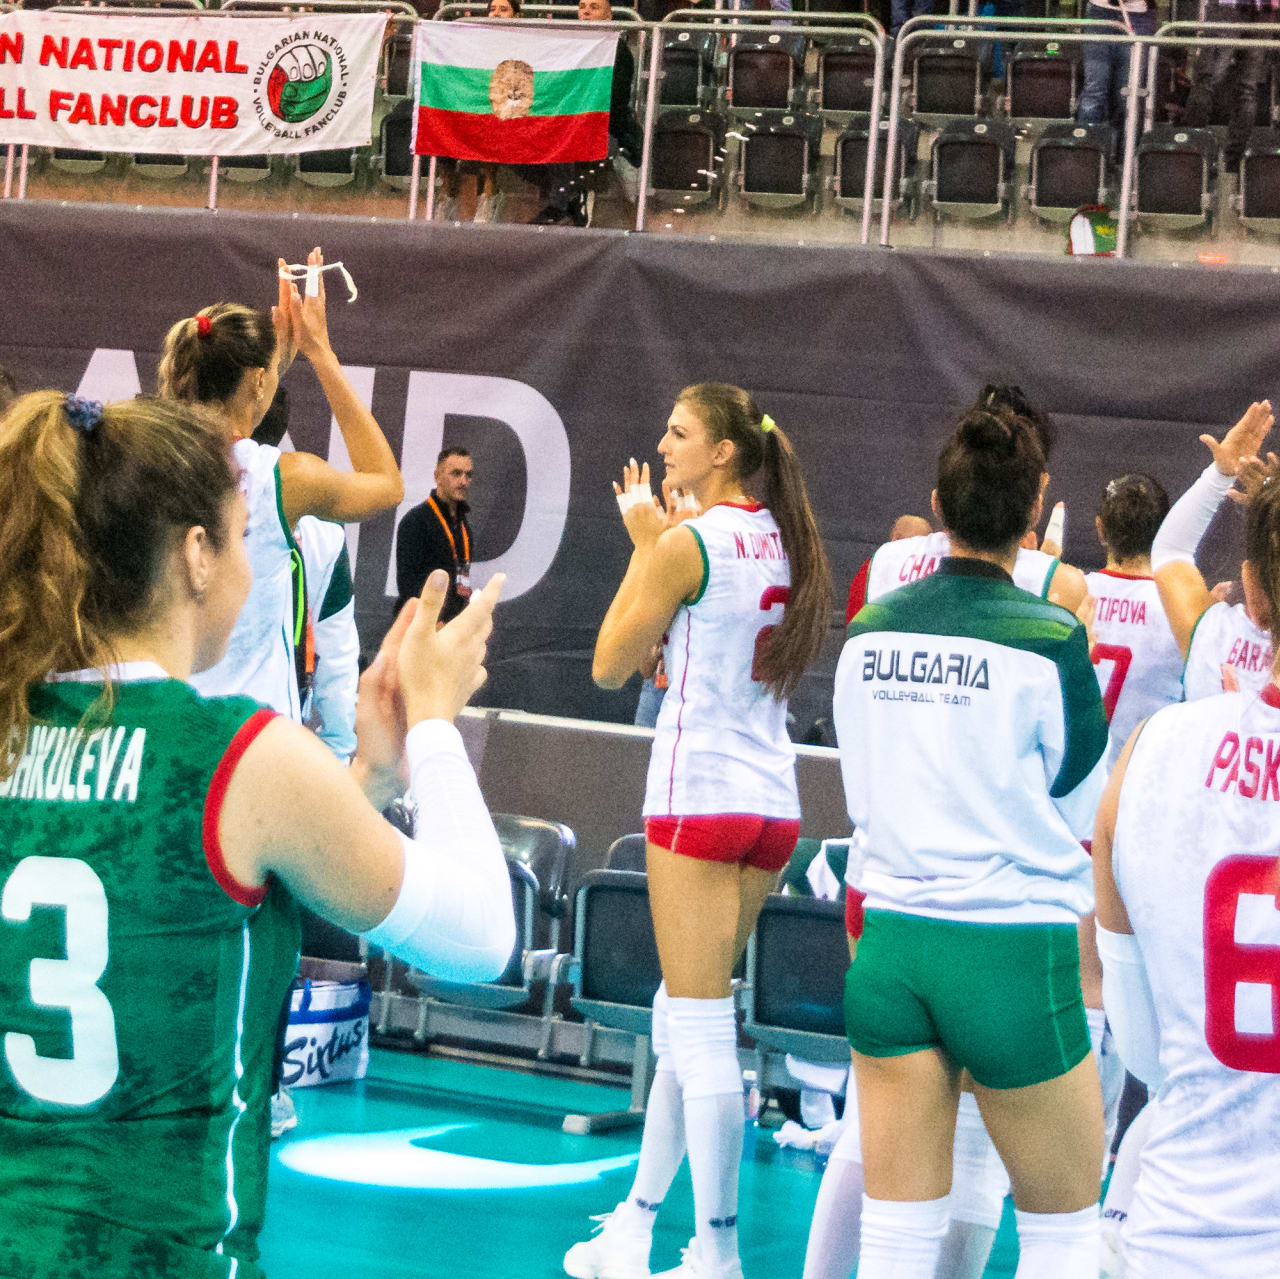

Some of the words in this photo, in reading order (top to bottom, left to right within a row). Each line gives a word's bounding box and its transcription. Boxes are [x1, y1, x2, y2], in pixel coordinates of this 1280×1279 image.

[39, 34, 248, 74] NATIONAL
[253, 30, 310, 85] BULGARIAN
[313, 30, 350, 80] NATIONAL
[49, 89, 239, 129] FANCLUB
[304, 90, 348, 136] FANCLUB
[862, 650, 990, 690] BULGARIA
[872, 689, 935, 704] VOLLEYBALL
[939, 693, 971, 707] TEAM
[279, 1020, 363, 1086] Sixtus
